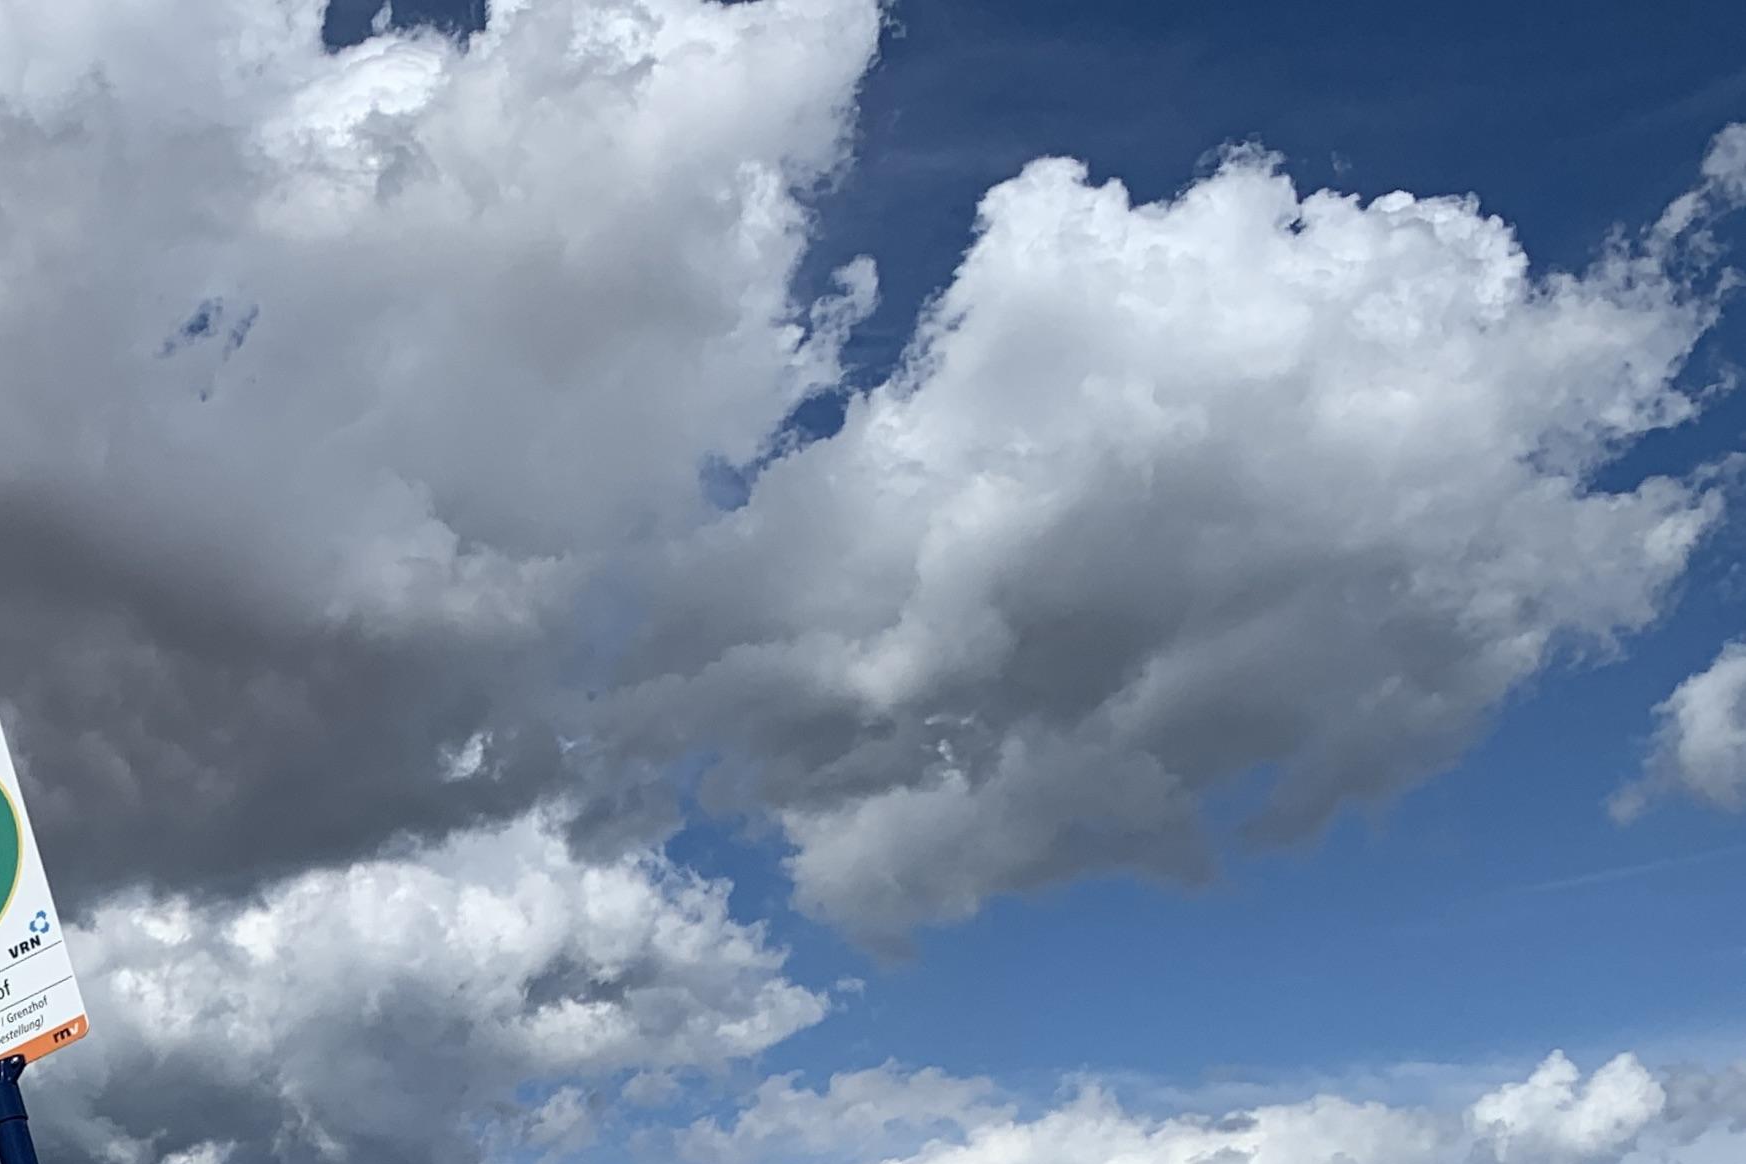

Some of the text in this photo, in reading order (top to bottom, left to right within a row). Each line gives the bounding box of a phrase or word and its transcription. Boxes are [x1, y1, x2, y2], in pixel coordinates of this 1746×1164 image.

[8, 935, 41, 959] VRN
[6, 995, 48, 1024] Grenzhof
[53, 1022, 79, 1043] rnv
